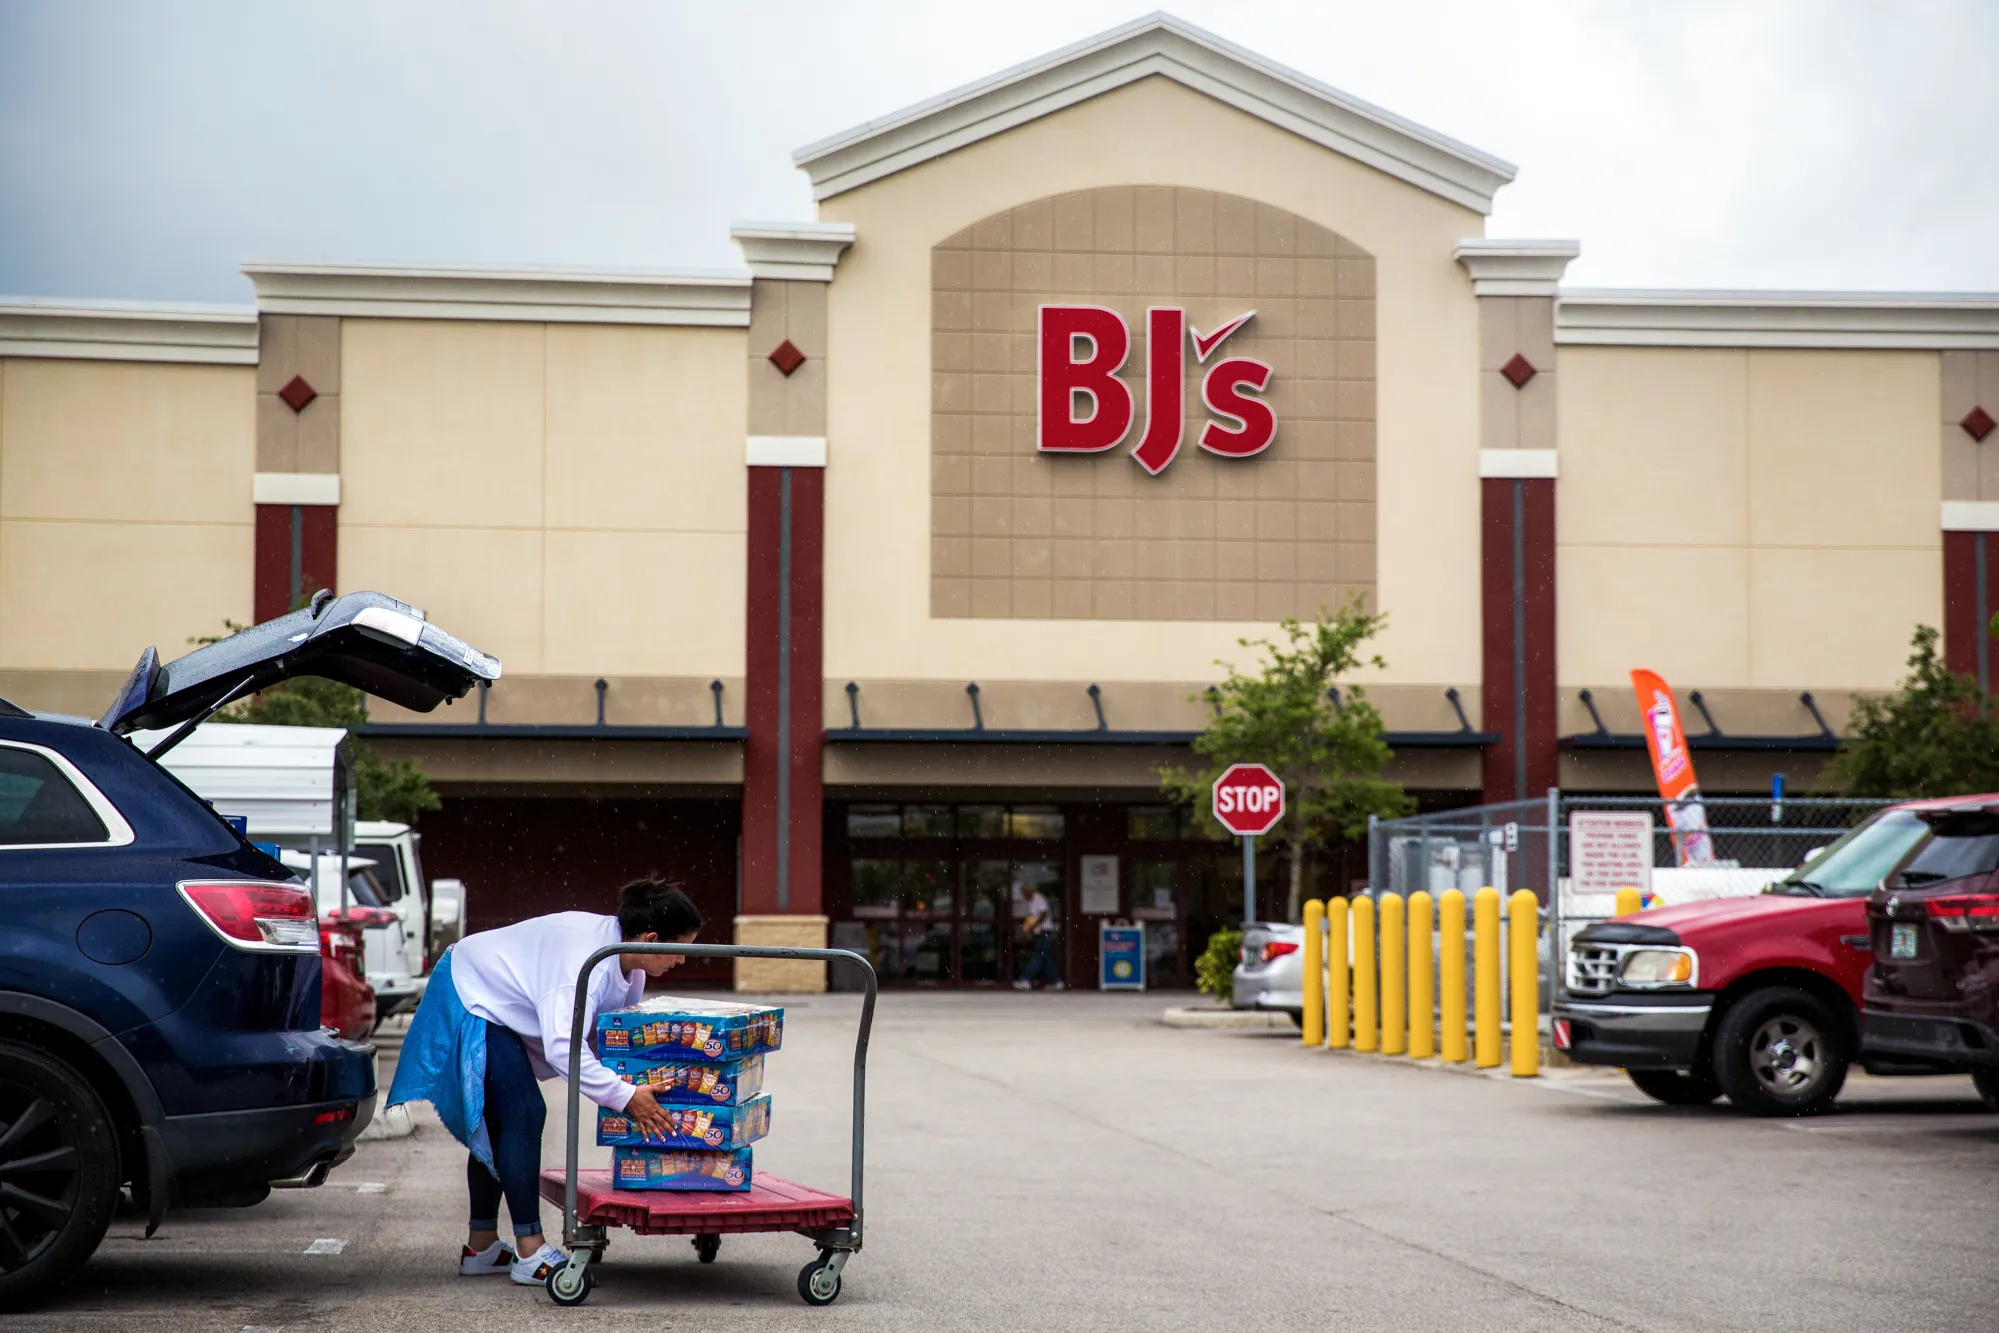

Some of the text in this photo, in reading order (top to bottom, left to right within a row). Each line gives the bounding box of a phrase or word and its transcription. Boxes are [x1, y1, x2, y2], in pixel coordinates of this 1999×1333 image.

[1218, 785, 1280, 813] STOP
[605, 1029, 629, 1037] GRAB
[704, 1041, 723, 1051] 50
[711, 1085, 730, 1095] 50
[704, 1130, 723, 1139] 50
[725, 1170, 744, 1179] 50
